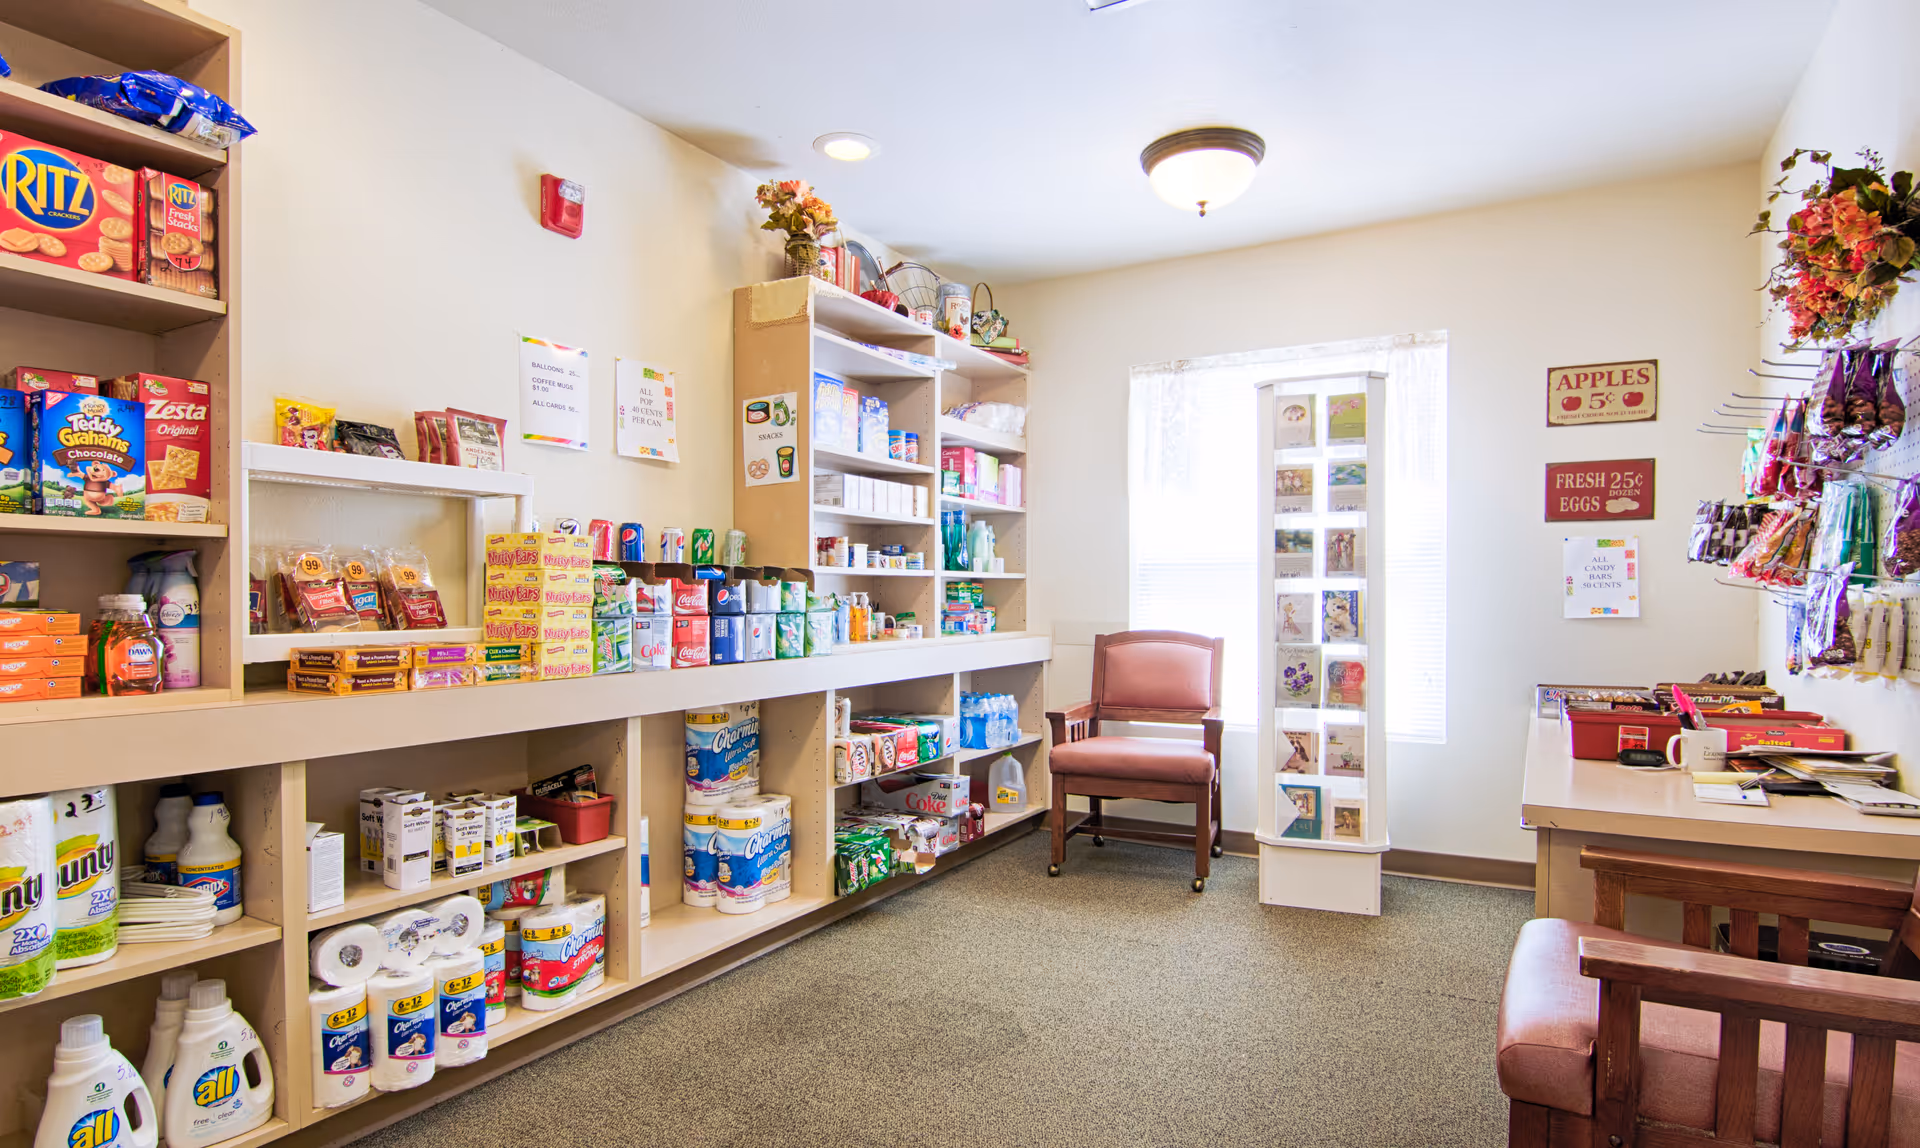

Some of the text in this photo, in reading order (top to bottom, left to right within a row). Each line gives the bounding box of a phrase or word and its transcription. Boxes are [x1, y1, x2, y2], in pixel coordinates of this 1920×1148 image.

[6, 153, 90, 216] RITZ
[168, 184, 196, 205] RITZ
[48, 211, 80, 220] CRACKERS
[169, 208, 195, 222] Fresh
[167, 216, 199, 232] Stacks
[532, 361, 565, 374] BALLOONS
[532, 377, 574, 391] COFFEE MUGS
[1555, 367, 1650, 392] APPLES
[532, 384, 550, 393] $1.00
[640, 387, 654, 397] ALL
[532, 399, 567, 411] ALL CARDS
[640, 396, 654, 406] POP
[1588, 391, 1616, 410] 5¢
[145, 399, 208, 421] Zesta
[641, 407, 664, 418] CENTS
[66, 412, 123, 438] Teddy
[632, 415, 662, 427] PER CAN
[156, 424, 199, 437] Original
[758, 432, 784, 441] SNACKS
[58, 427, 131, 454] Grahams
[66, 449, 125, 464] Chocolate
[1556, 471, 1644, 489] FRESH 25¢
[1609, 488, 1641, 497] DOZEN
[1335, 503, 1359, 512] Get Well
[1560, 495, 1601, 513] EGGS
[487, 547, 539, 569] Nutty Bars
[543, 554, 591, 570] Nutty Bars
[1584, 564, 1616, 572] CANDY
[1589, 572, 1613, 581] BARS
[1592, 581, 1622, 589] CENTS
[309, 591, 341, 601] Strawberry
[352, 594, 376, 607] ugar
[488, 584, 540, 605] Nutty Bars
[545, 591, 592, 605] Nutty Bars
[486, 620, 539, 642] Nutty Bars
[544, 627, 590, 641] Nutty Bars
[128, 647, 153, 657] DAWN
[641, 643, 668, 658] Coke
[544, 663, 591, 677] Nutty Bars
[712, 716, 760, 754] Charmin
[724, 736, 756, 763] Ultra Soft
[535, 780, 564, 795] DURACELL
[905, 792, 947, 814] Coke
[930, 791, 948, 801] Diet
[955, 796, 969, 808] Coke
[361, 813, 375, 822] Soft
[415, 819, 431, 827] White
[504, 813, 516, 821] White
[744, 817, 791, 860] Charmin
[942, 832, 957, 846] Coke
[757, 838, 788, 868] Ultra Soft
[57, 839, 114, 892] unty
[186, 864, 225, 873] CONCENTRATED
[92, 890, 110, 905] 2X
[14, 928, 38, 944] 2X
[560, 918, 605, 964] Charmin
[10, 936, 50, 955] Absorbent
[572, 944, 601, 970] STRONG
[449, 977, 472, 989] 6 12
[412, 995, 422, 1004] 12
[445, 993, 475, 1012] Charmin
[333, 1008, 357, 1022] 6 12
[394, 1013, 426, 1034] Charmin
[329, 1026, 361, 1048] Charmin
[196, 1064, 237, 1106] all
[193, 1109, 236, 1127] free clear
[71, 1106, 115, 1148] all
